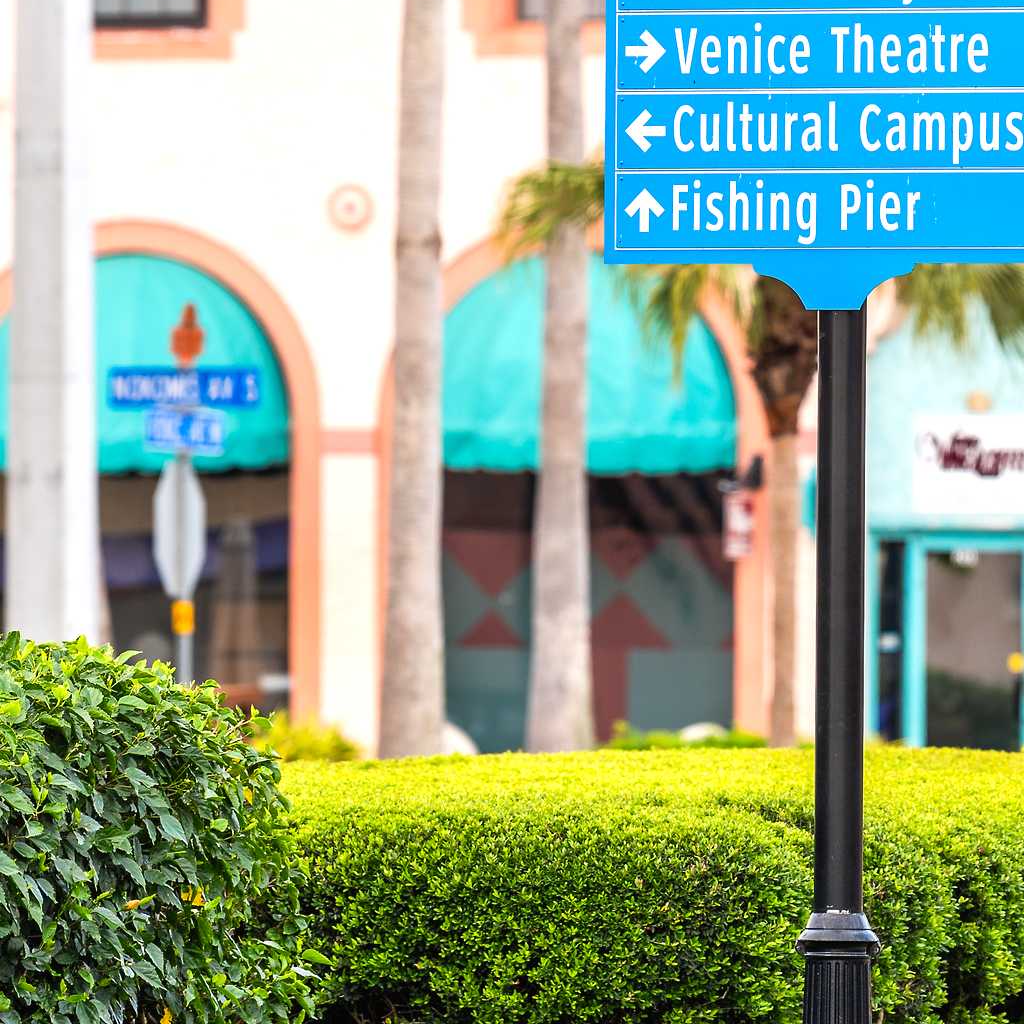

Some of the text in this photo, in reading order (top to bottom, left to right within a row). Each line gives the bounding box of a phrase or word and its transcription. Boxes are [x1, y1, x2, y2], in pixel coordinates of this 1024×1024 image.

[674, 22, 990, 75] Venice Theatre
[672, 101, 1024, 165] Cultural Campus
[671, 179, 921, 245] Fishing Pier
